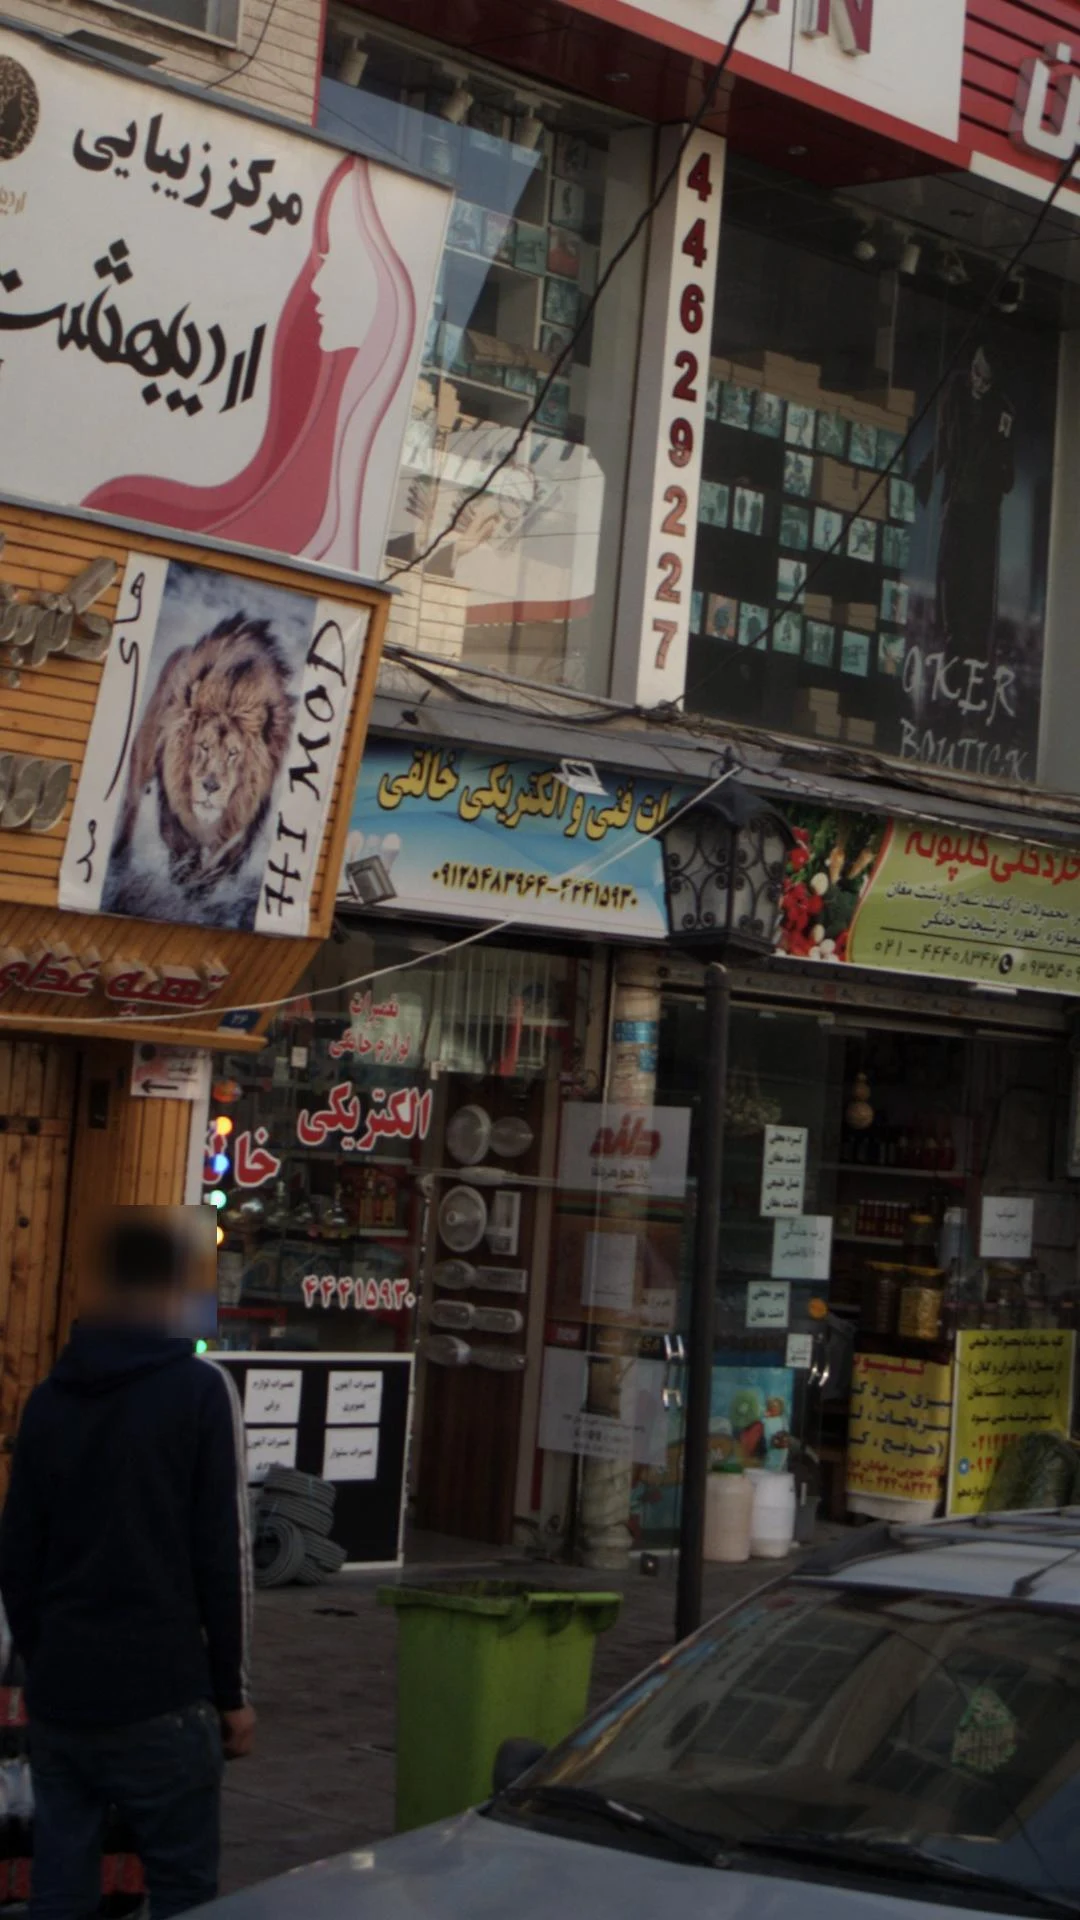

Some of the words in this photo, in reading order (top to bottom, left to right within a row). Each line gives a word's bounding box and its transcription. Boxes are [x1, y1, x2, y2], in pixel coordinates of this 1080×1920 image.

[73, 113, 211, 207] زیبایی
[211, 159, 304, 235] مرکز
[652, 152, 712, 671] 44629227
[377, 746, 459, 811] خالقی
[458, 761, 569, 830] الکتریکی
[585, 778, 634, 841] فنی
[564, 790, 585, 838] و
[298, 1081, 433, 1151] الکتریکی
[302, 1275, 417, 1311] ۴۴۴۱۵۹۳۰
